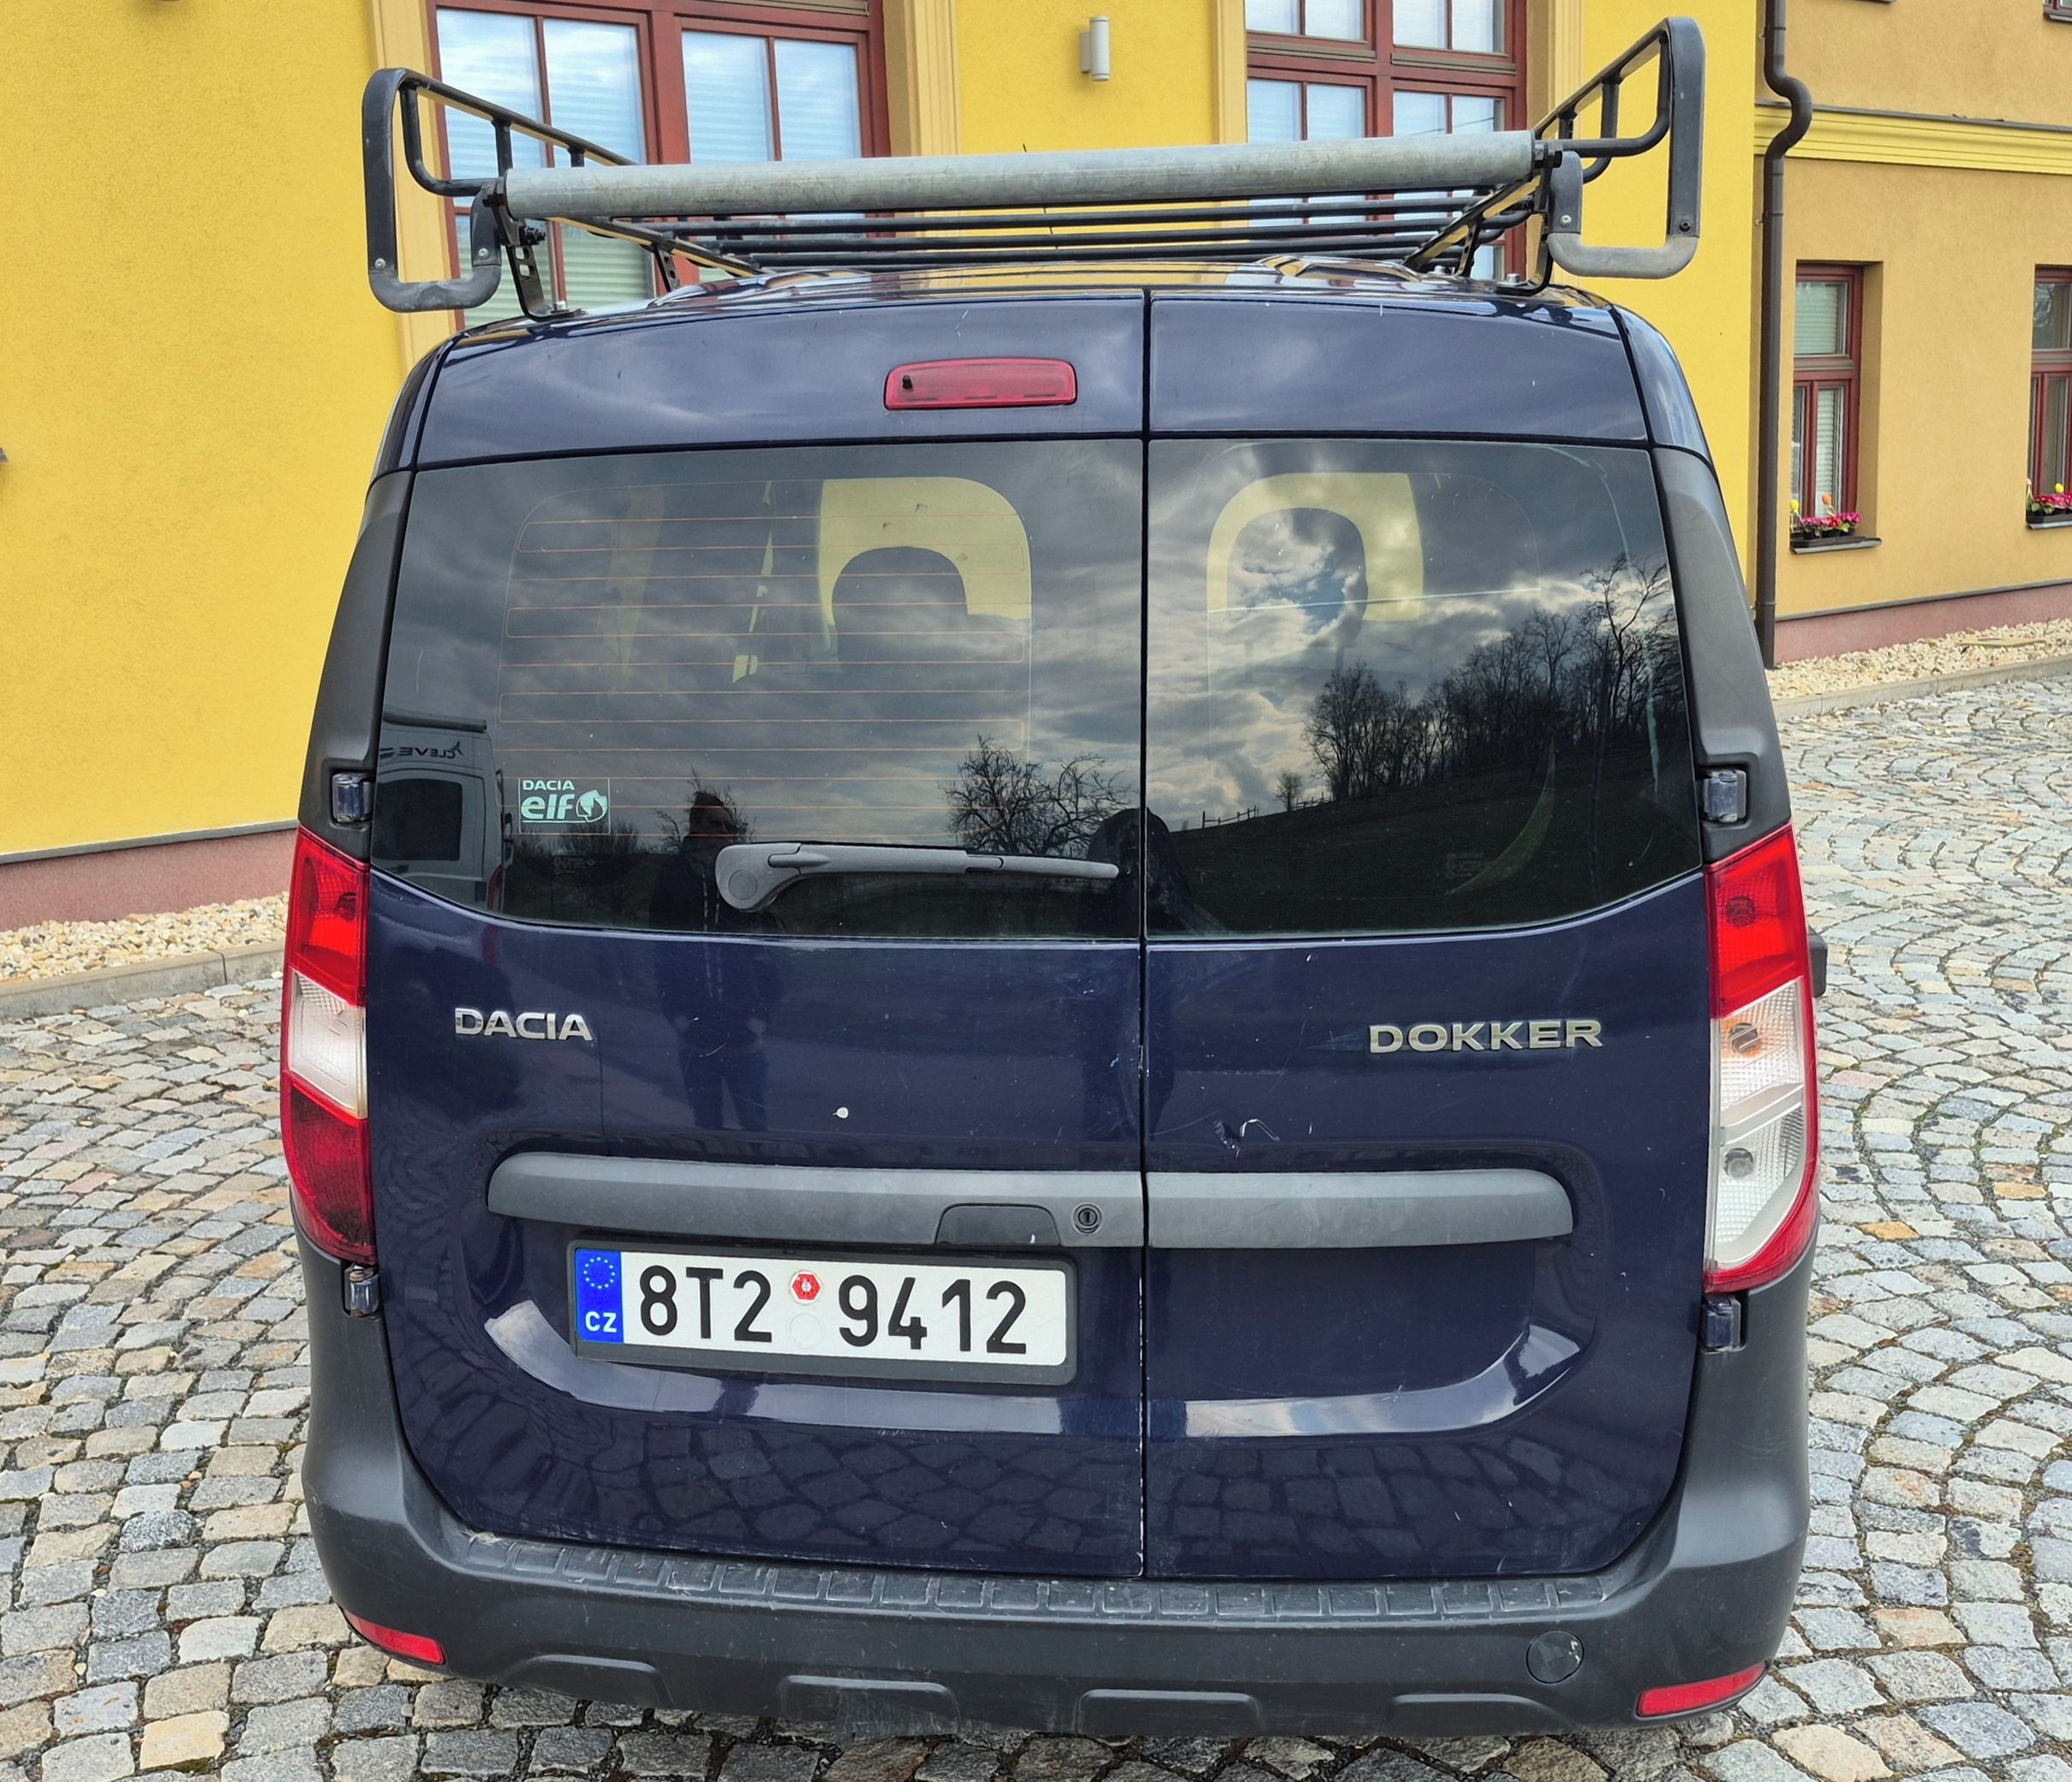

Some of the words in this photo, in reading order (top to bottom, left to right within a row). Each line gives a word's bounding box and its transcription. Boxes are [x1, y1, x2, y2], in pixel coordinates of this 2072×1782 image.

[522, 779, 576, 791] DACIA
[521, 794, 576, 819] elf
[454, 1007, 594, 1041] DACIA
[1369, 1019, 1603, 1054] DOKKER
[584, 1310, 618, 1334] CZ
[639, 1264, 773, 1344] 8T2
[838, 1274, 1027, 1355] 9412
